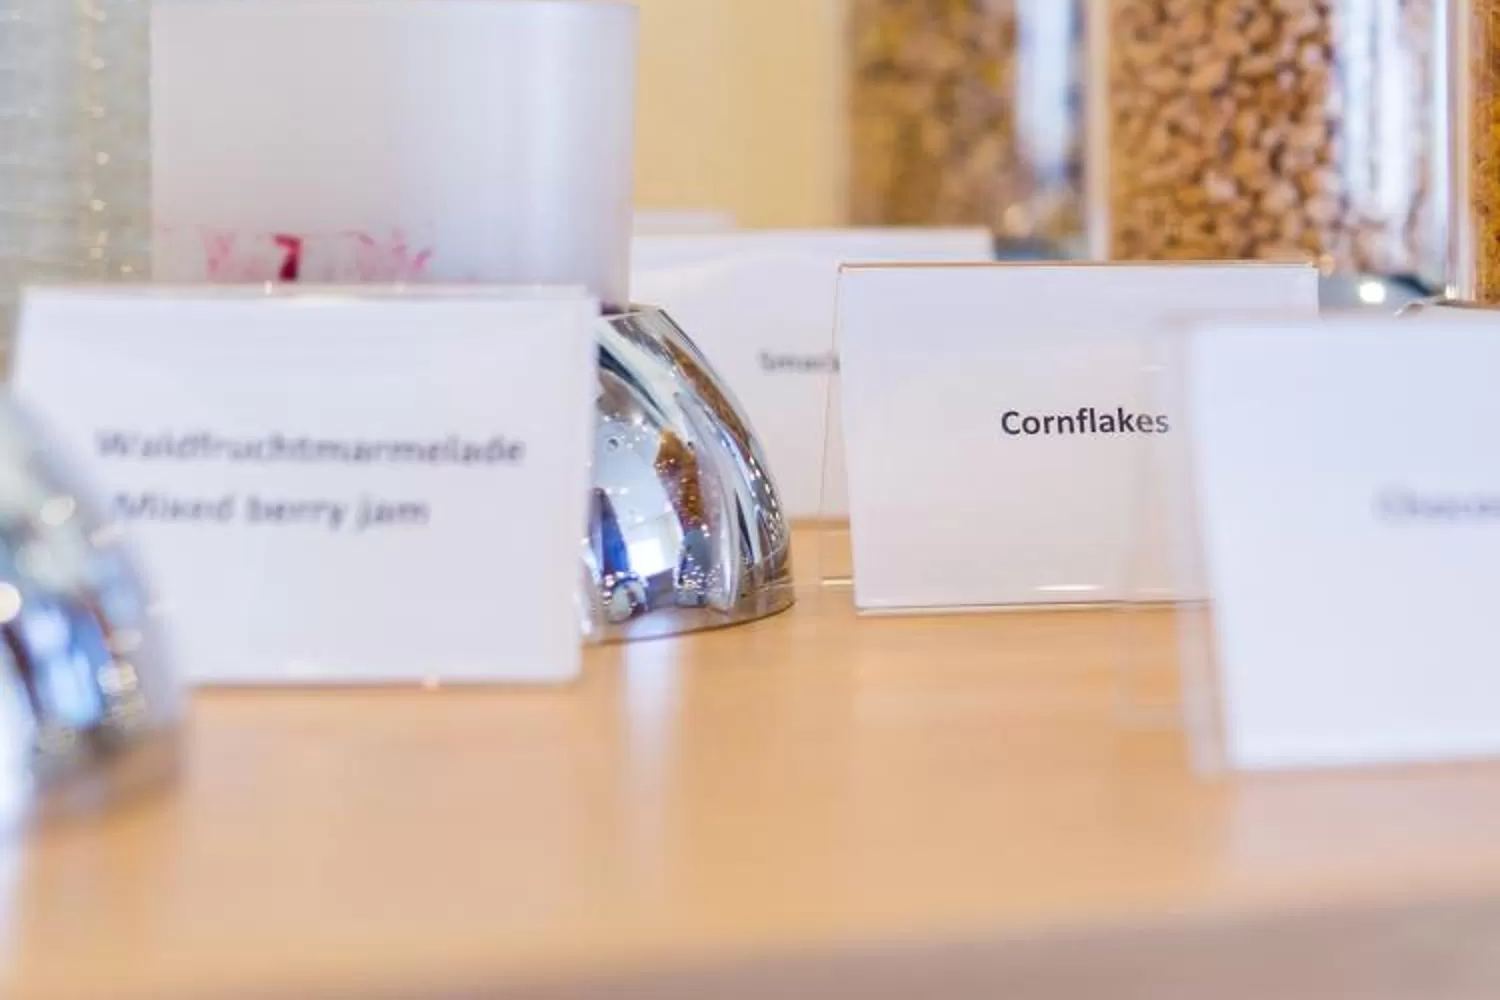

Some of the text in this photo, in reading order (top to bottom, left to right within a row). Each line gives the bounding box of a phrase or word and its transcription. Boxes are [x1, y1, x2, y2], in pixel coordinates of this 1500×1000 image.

[1001, 407, 1169, 436] Cornflakes
[95, 428, 525, 467] Waldfruchtmarmelade
[248, 492, 346, 531] berry
[355, 493, 431, 531] jam
